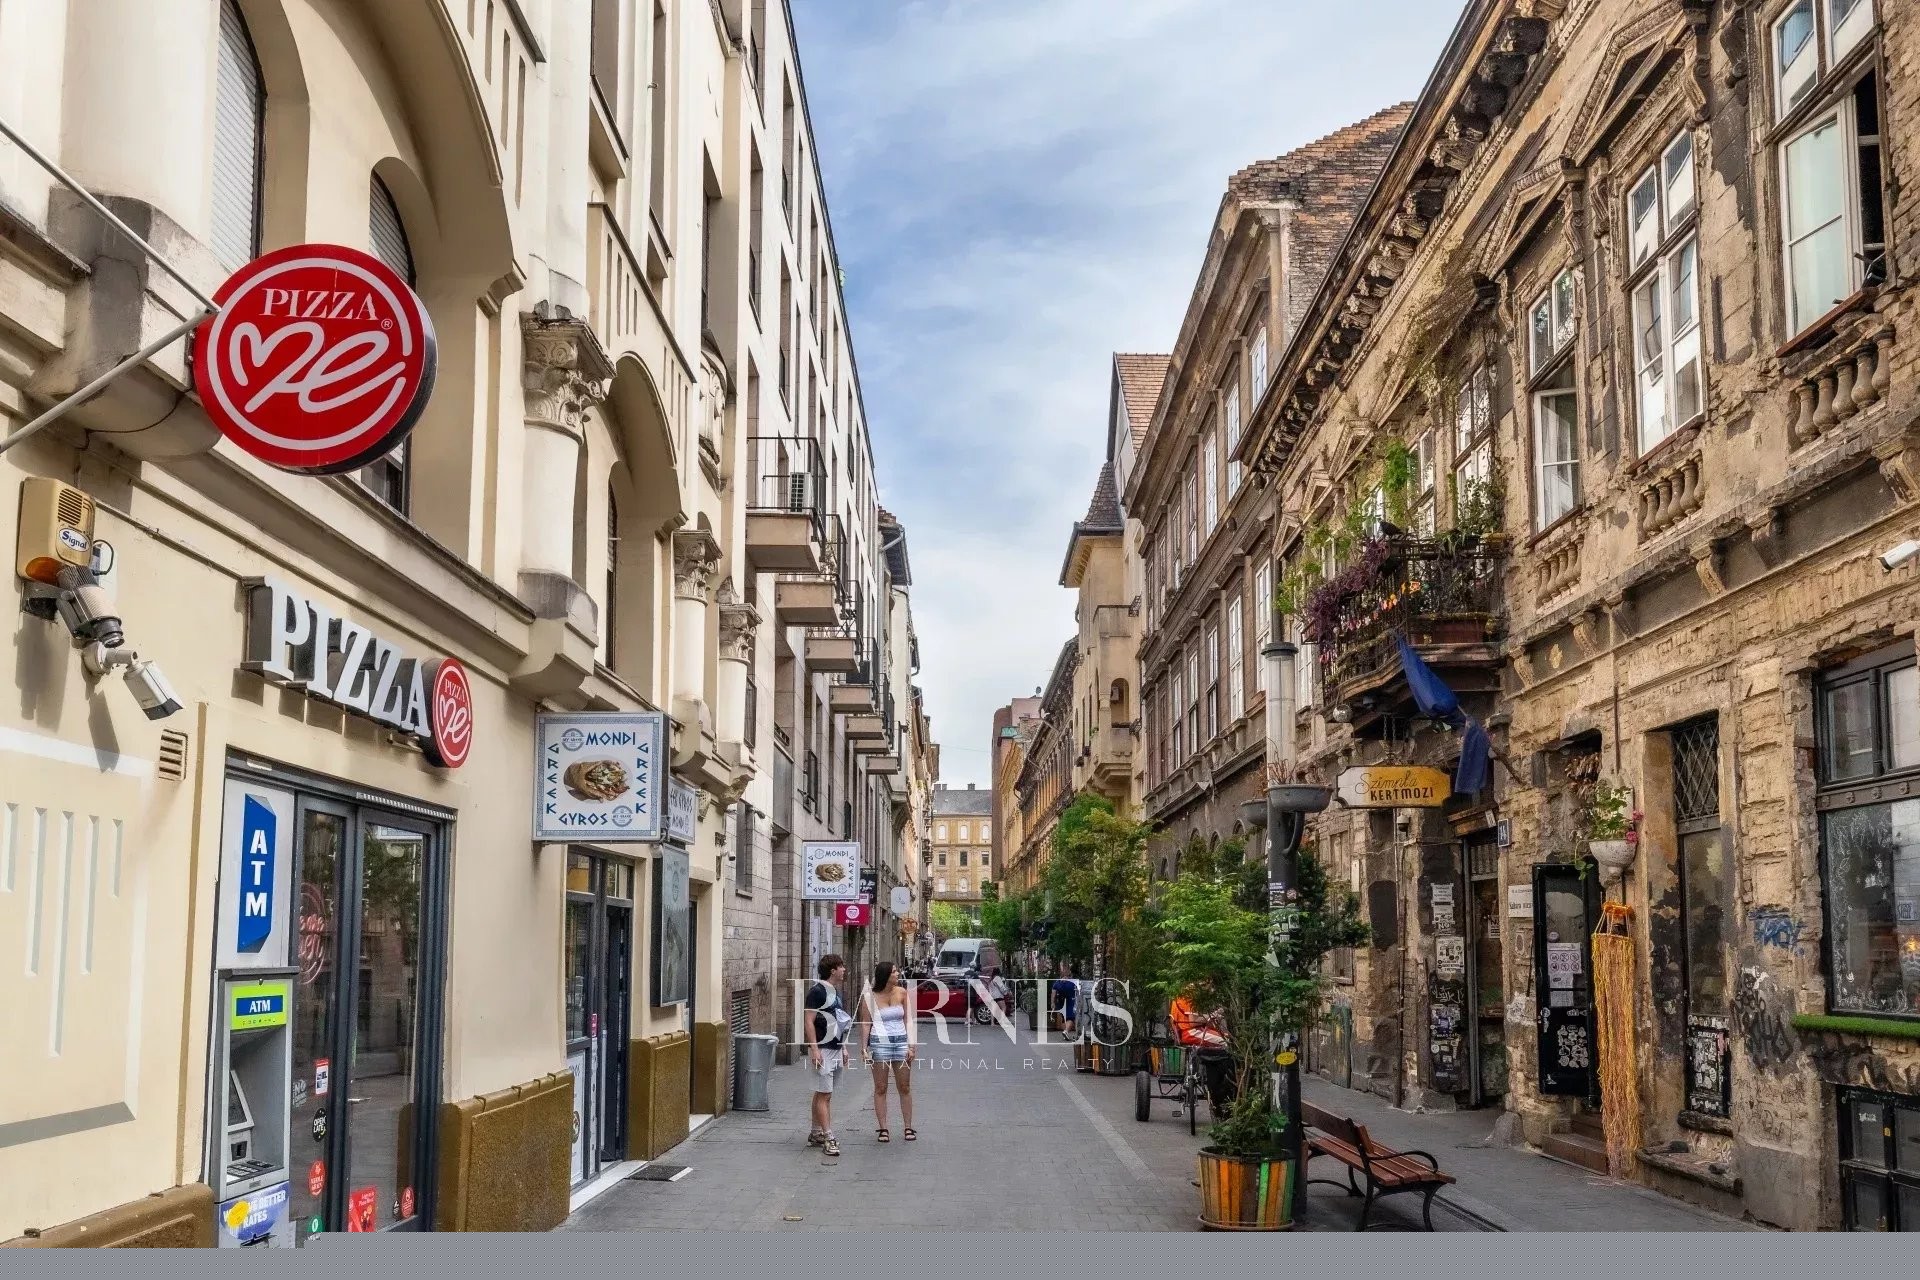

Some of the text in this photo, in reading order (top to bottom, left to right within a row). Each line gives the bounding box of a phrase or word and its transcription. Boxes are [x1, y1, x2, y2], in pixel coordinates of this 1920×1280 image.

[259, 288, 379, 321] PIZZA
[62, 530, 88, 549] Signal
[264, 576, 431, 738] PIZZA
[444, 678, 466, 702] PIZZA
[585, 731, 636, 746] MONDI
[546, 742, 560, 815] GREEK
[635, 742, 649, 815] GREEK
[1370, 786, 1434, 801] KERTMOZI
[558, 812, 609, 826] GYROS
[245, 829, 268, 917] ATM
[249, 999, 271, 1014] ATM
[313, 1116, 326, 1127] OPEN
